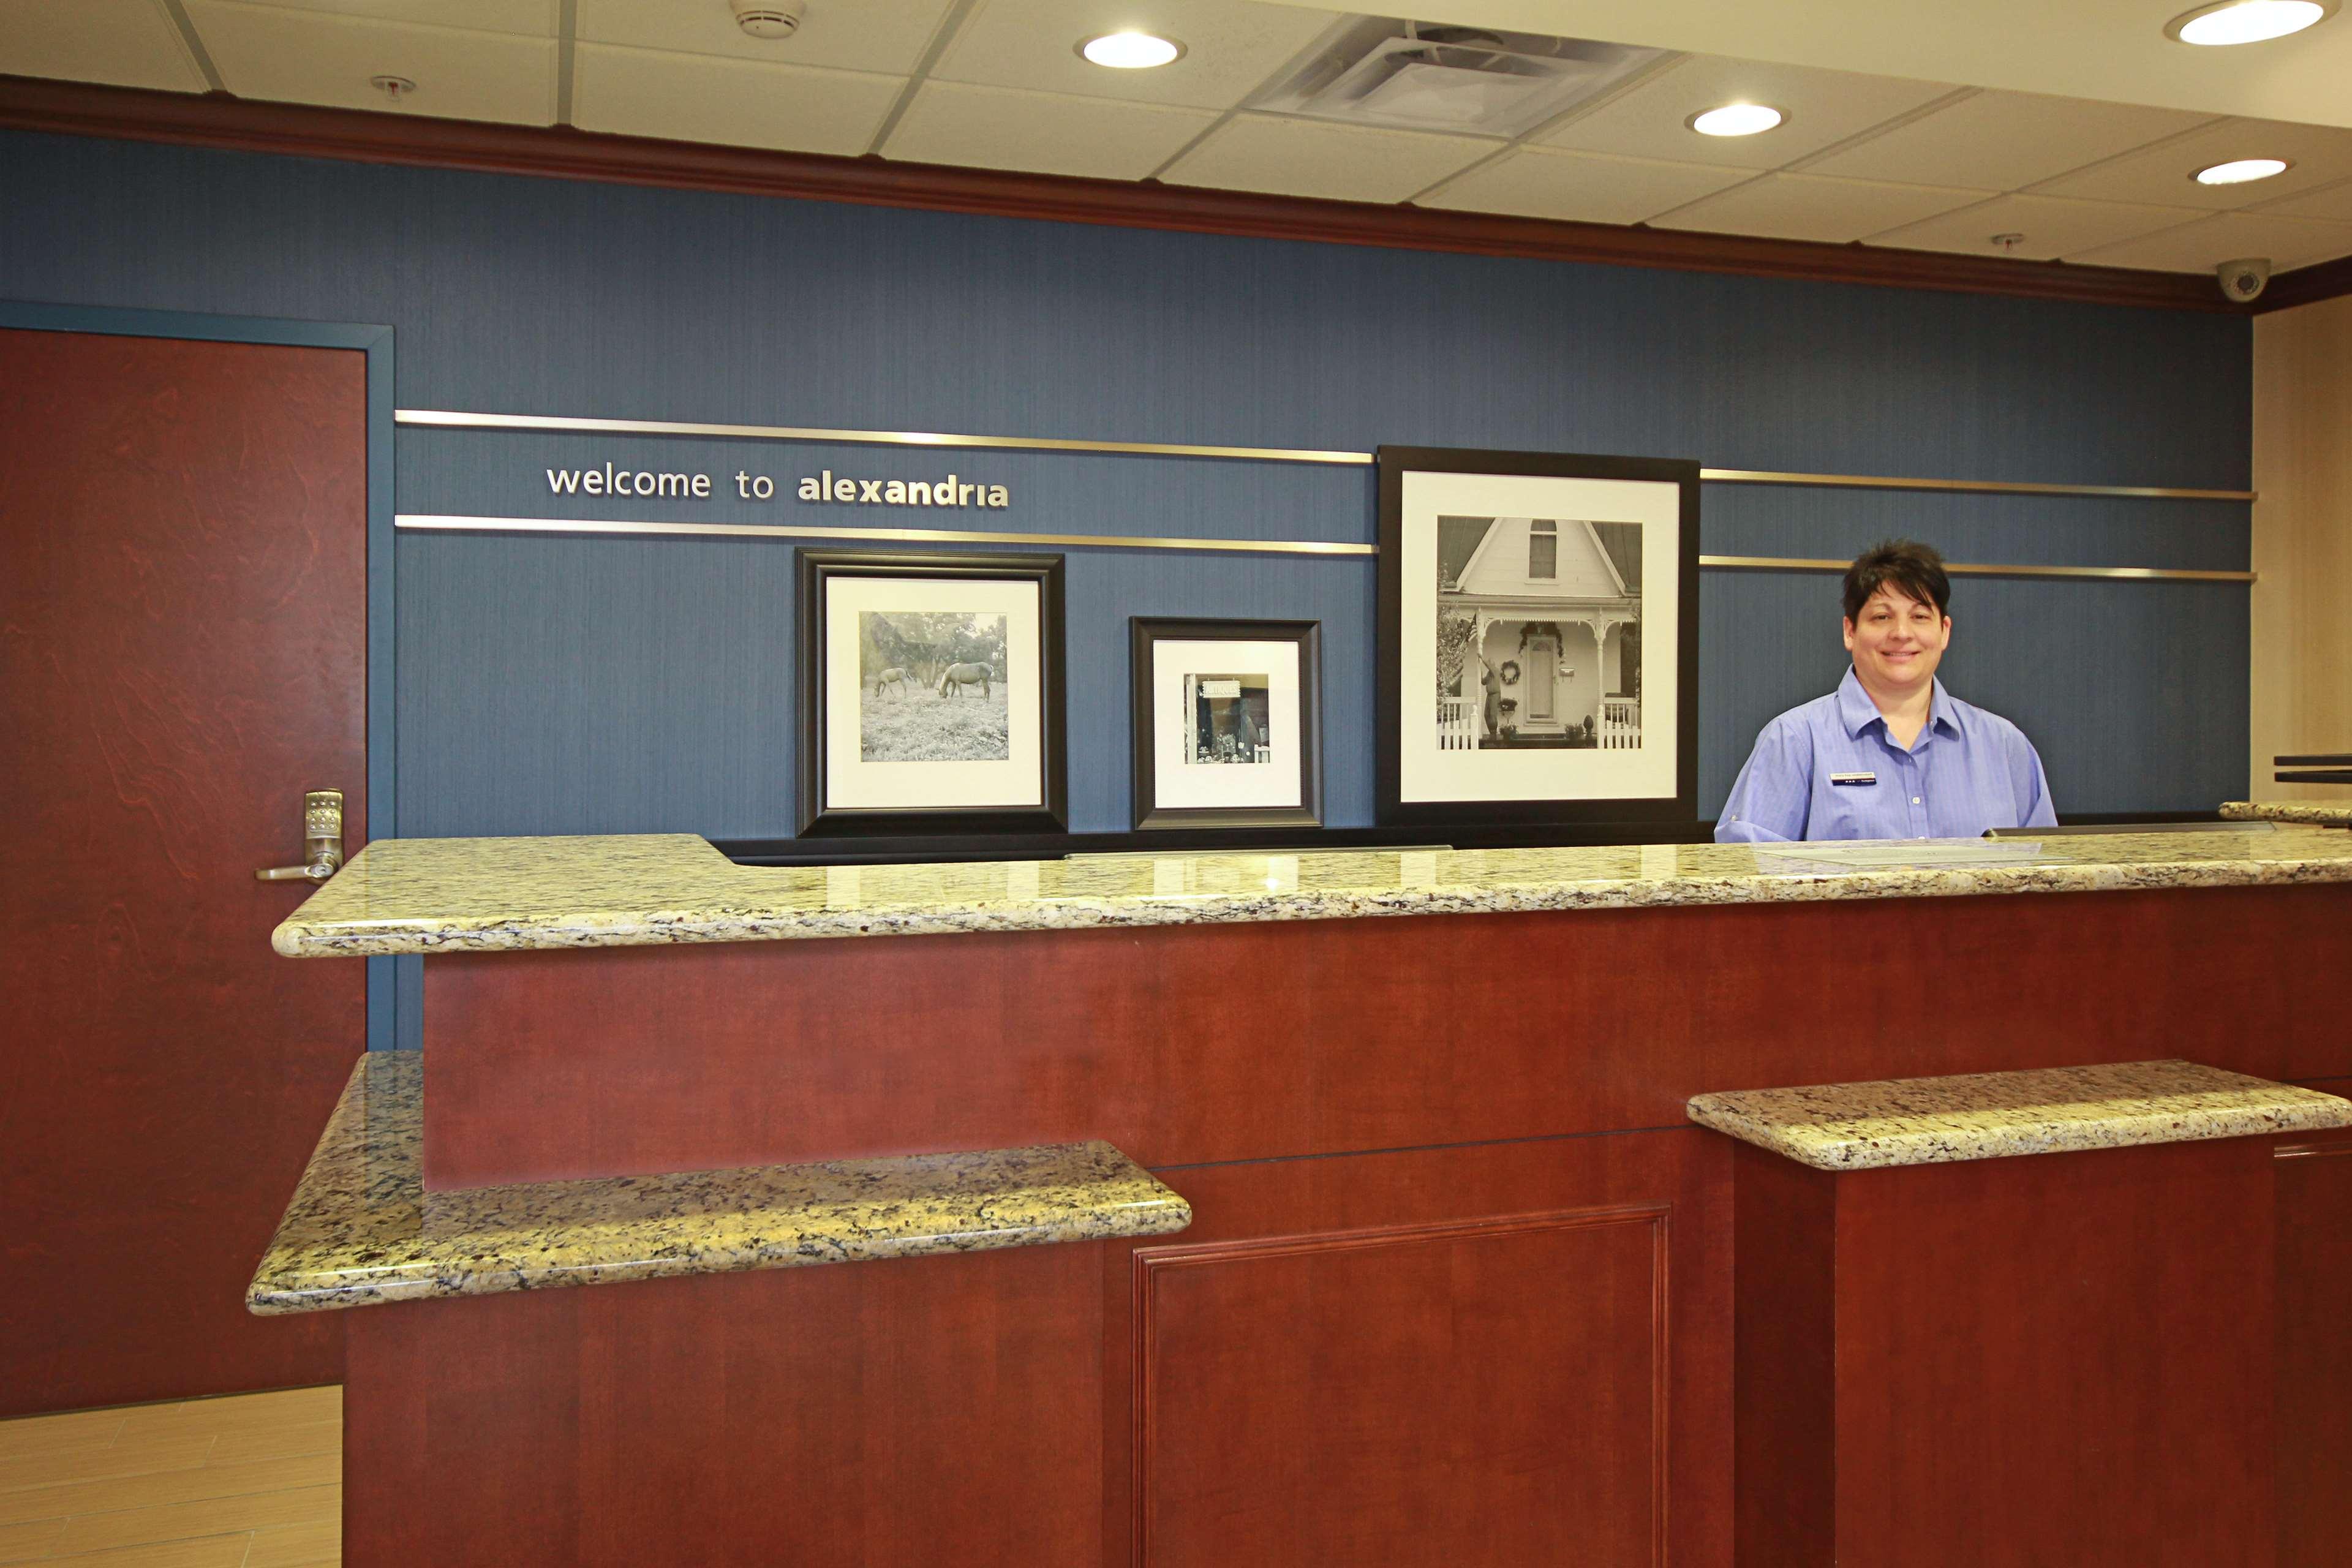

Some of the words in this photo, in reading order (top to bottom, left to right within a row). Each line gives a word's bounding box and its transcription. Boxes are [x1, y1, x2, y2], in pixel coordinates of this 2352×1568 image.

[546, 462, 710, 497] welcome
[735, 470, 774, 499] to
[798, 470, 1009, 507] alexandria
